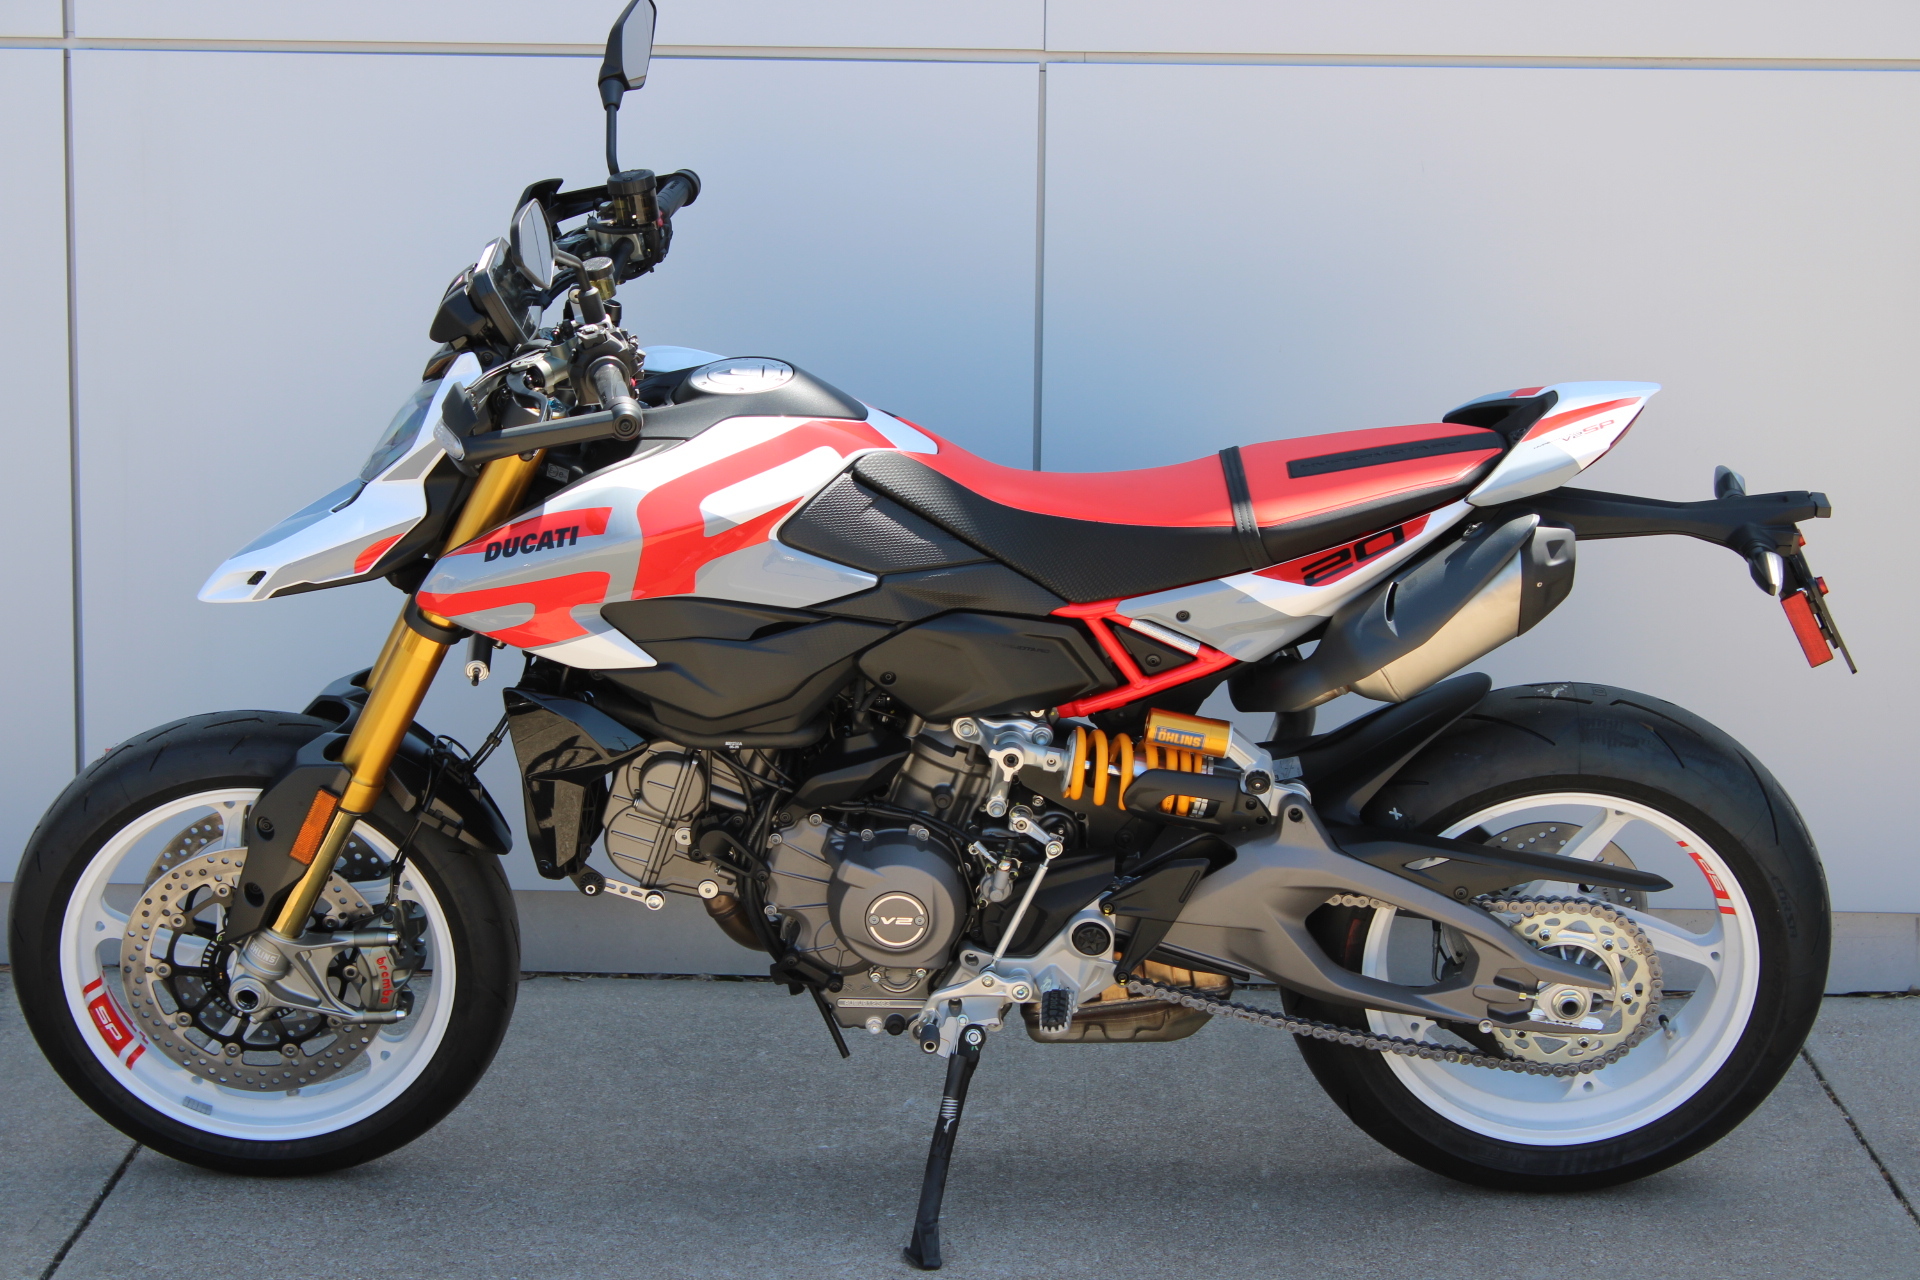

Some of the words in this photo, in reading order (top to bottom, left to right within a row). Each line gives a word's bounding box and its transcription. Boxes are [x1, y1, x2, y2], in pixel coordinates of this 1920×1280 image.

[484, 525, 580, 563] DUCATI
[1301, 524, 1406, 587] 20
[1157, 728, 1203, 748] ÖHLINS
[880, 916, 914, 925] V2
[376, 956, 394, 1004] brembo
[94, 1005, 123, 1041] SP
